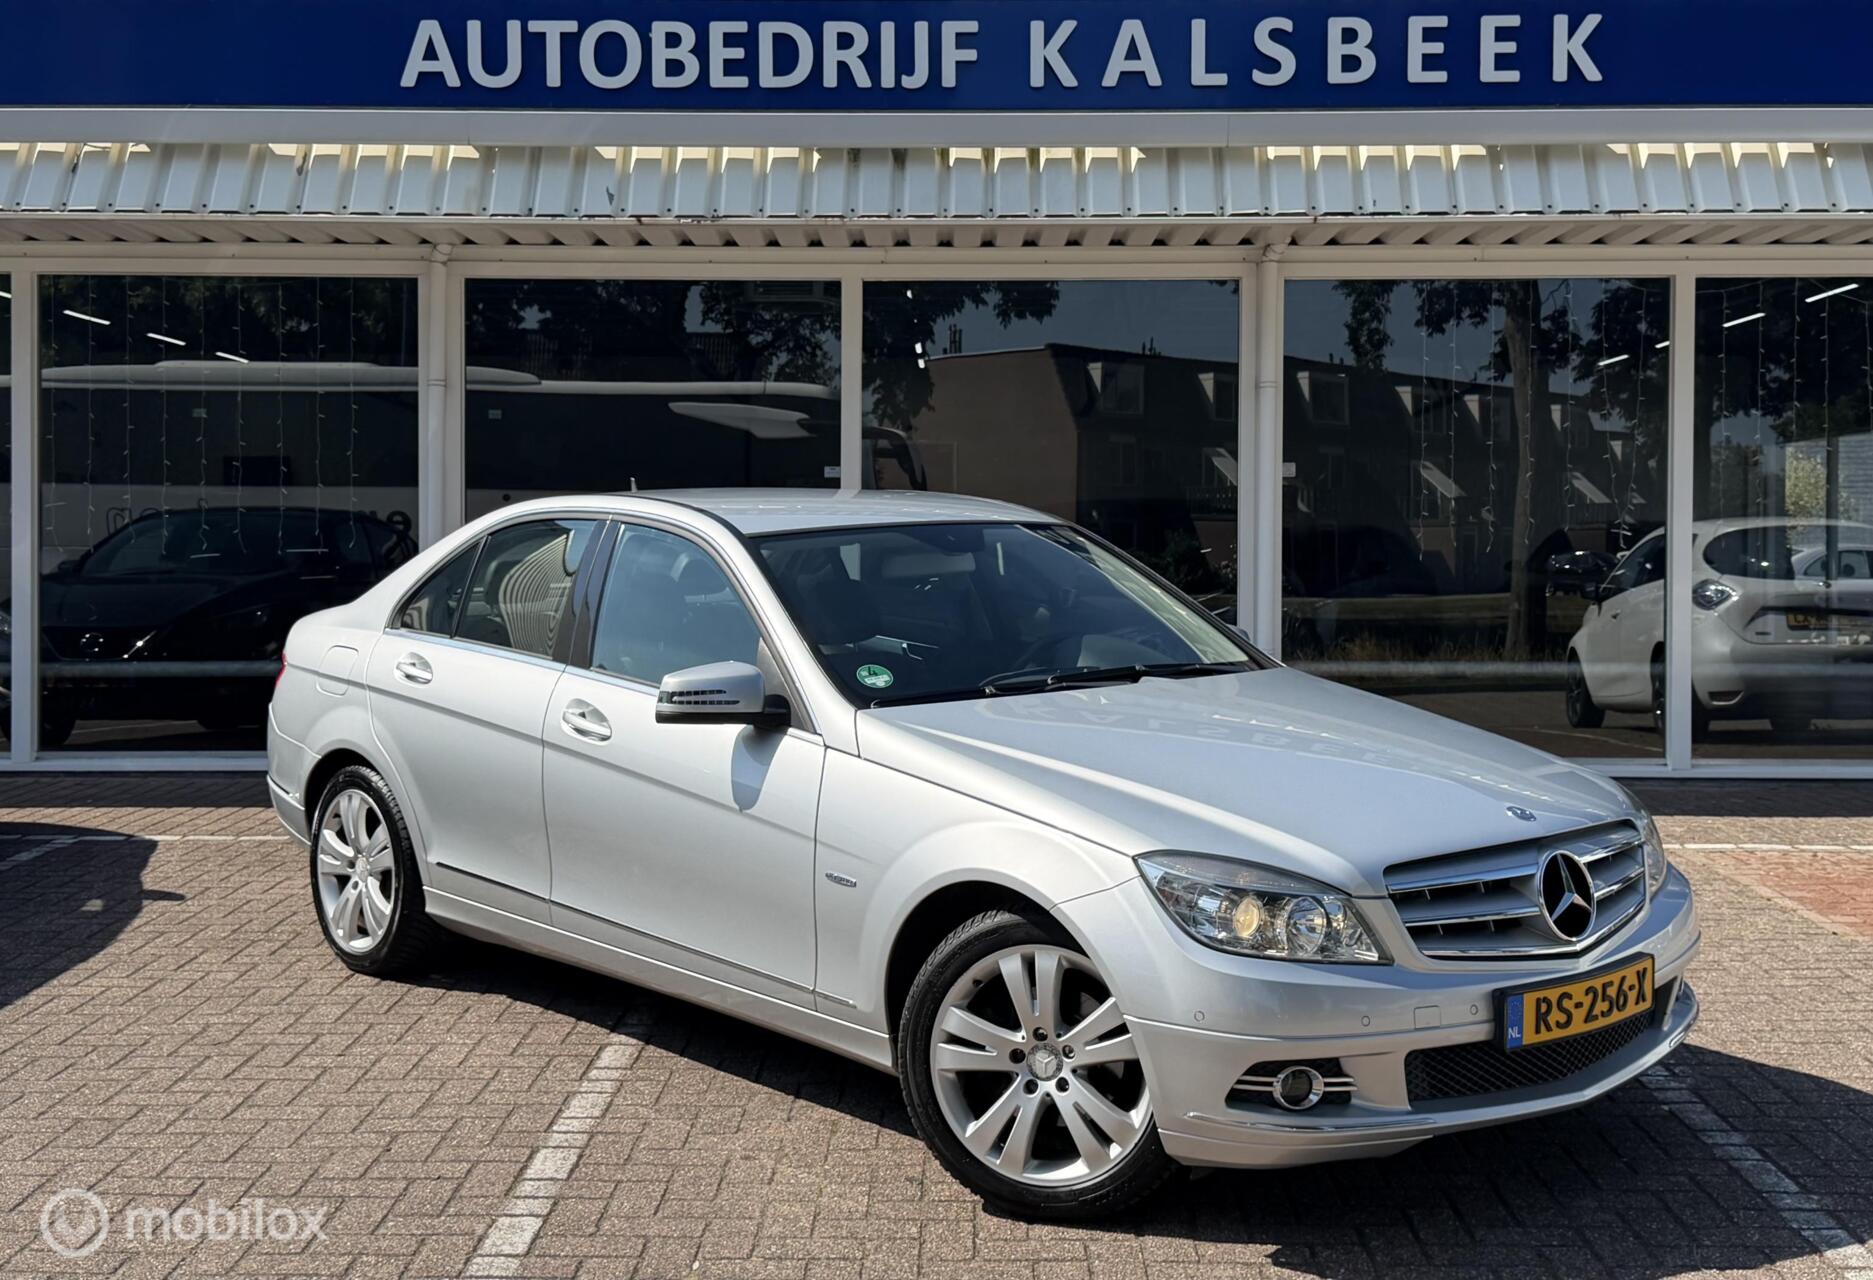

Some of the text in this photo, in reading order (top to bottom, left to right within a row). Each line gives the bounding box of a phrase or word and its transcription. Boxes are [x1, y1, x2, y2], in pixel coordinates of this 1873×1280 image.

[400, 14, 1603, 89] AUTOBEDRIJF KALSBEEK
[1508, 1026, 1521, 1039] NL
[1534, 967, 1648, 1034] RS-256-X
